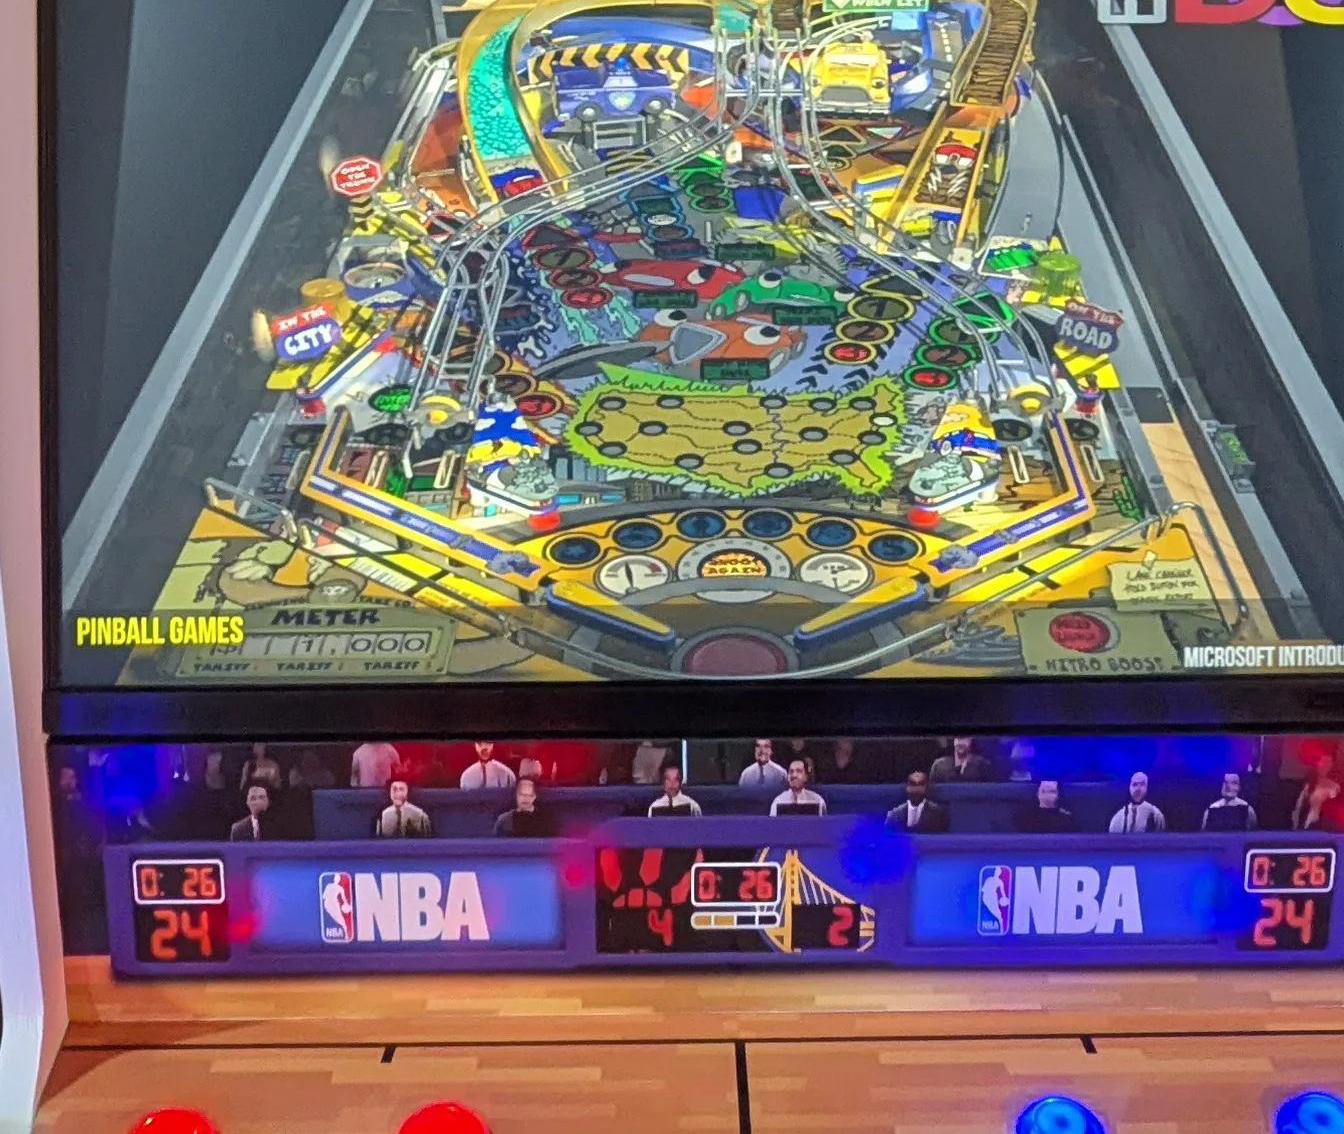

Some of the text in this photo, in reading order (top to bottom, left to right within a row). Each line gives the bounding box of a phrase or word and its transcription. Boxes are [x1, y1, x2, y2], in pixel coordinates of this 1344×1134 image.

[284, 323, 333, 356] CITY
[1058, 316, 1113, 350] ROAD
[76, 617, 245, 647] PINBALL GAMES
[272, 607, 381, 628] METER
[1045, 656, 1103, 672] NITRO
[1184, 647, 1275, 668] MICROSOFT
[355, 872, 490, 941] NBA
[1012, 865, 1144, 935] NBA
[149, 909, 212, 959] 24
[647, 905, 854, 947] 4 2
[1253, 898, 1316, 947] 24
